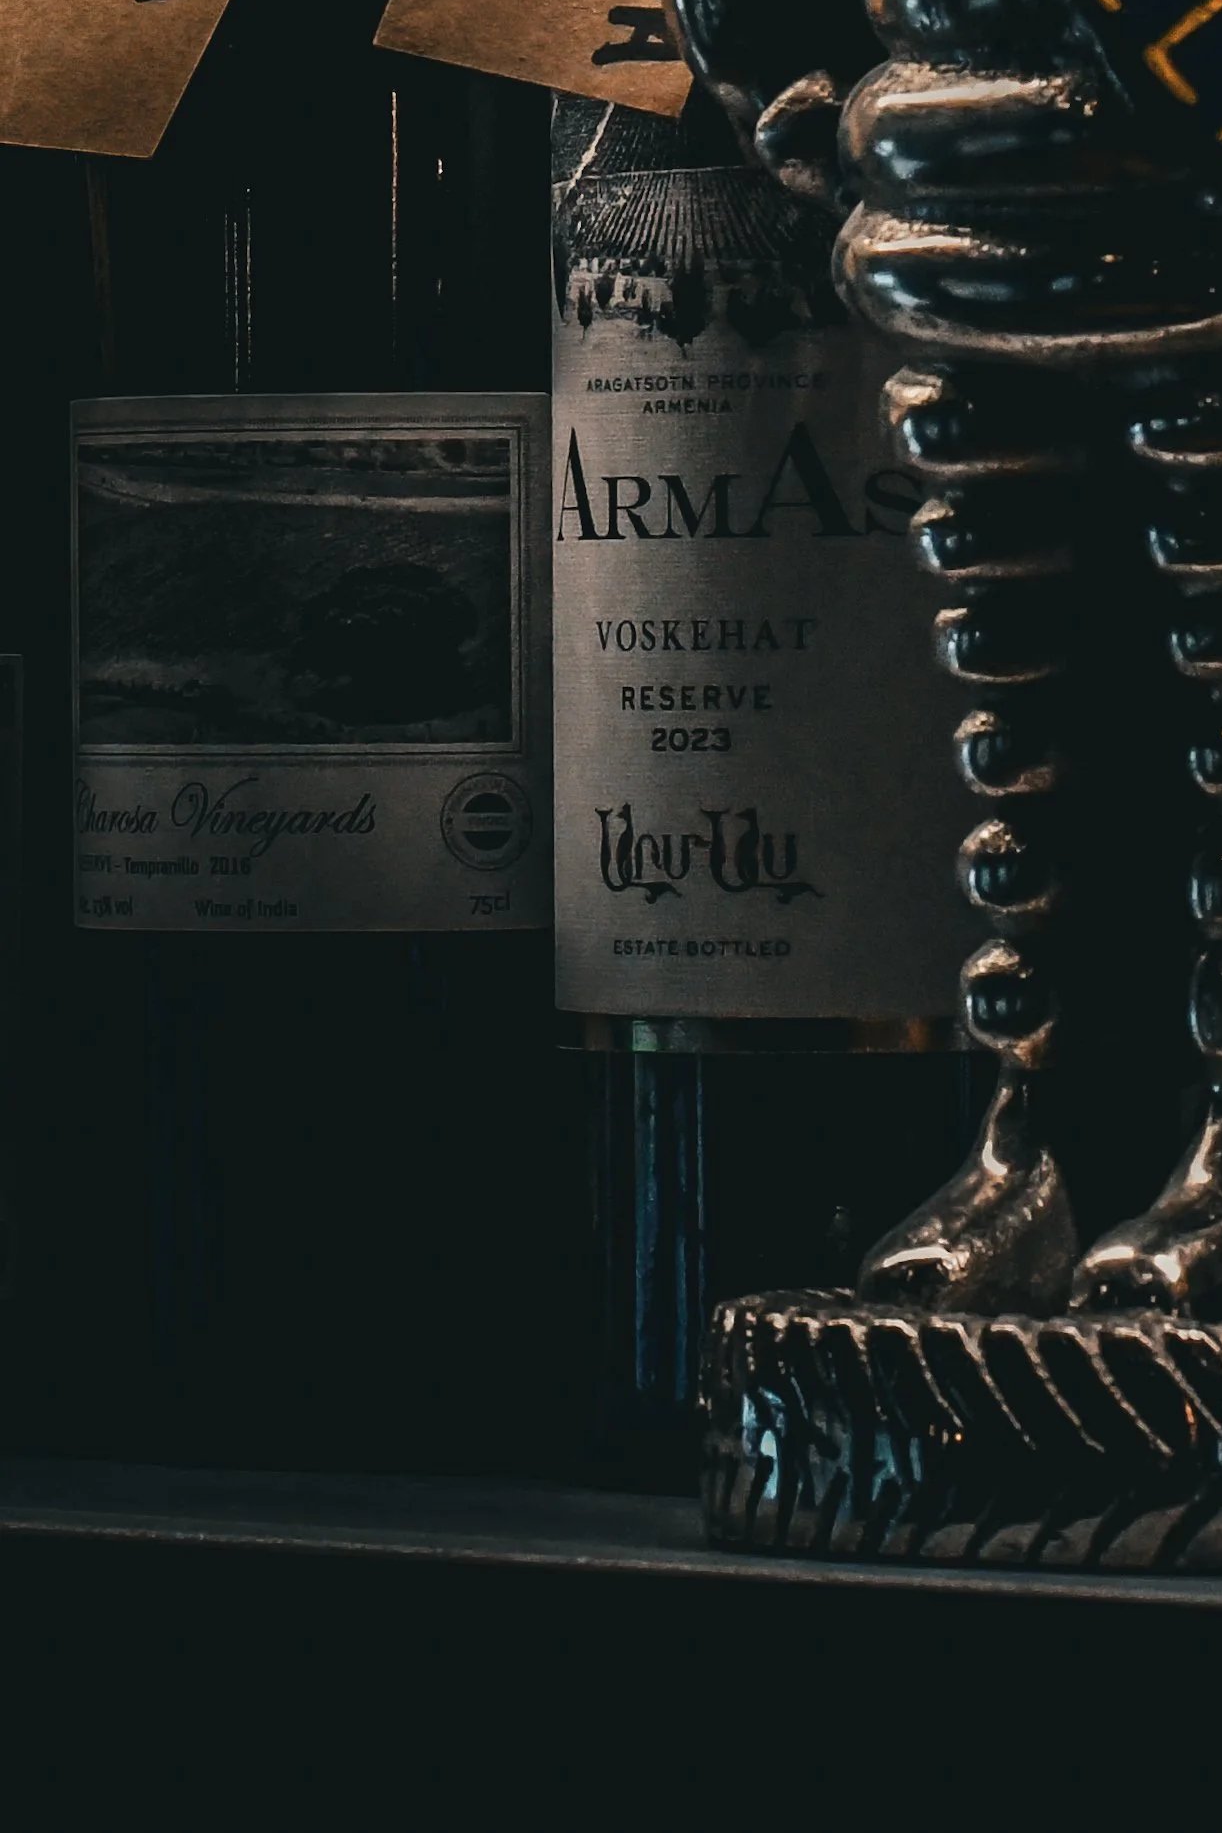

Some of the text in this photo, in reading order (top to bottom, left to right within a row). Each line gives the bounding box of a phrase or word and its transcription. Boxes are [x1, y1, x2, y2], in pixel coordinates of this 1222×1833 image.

[708, 373, 824, 391] PROVINCE
[642, 397, 733, 414] ARMENIA
[595, 618, 817, 651] VOSKEHAT
[621, 685, 772, 711] RESERVE
[651, 727, 732, 752] 2023
[75, 778, 159, 834] Charosa
[171, 777, 376, 857] Vineyards
[209, 855, 252, 876] 2016
[194, 896, 298, 920] Wine of India
[613, 939, 791, 957] ESTATE BOTTLED
